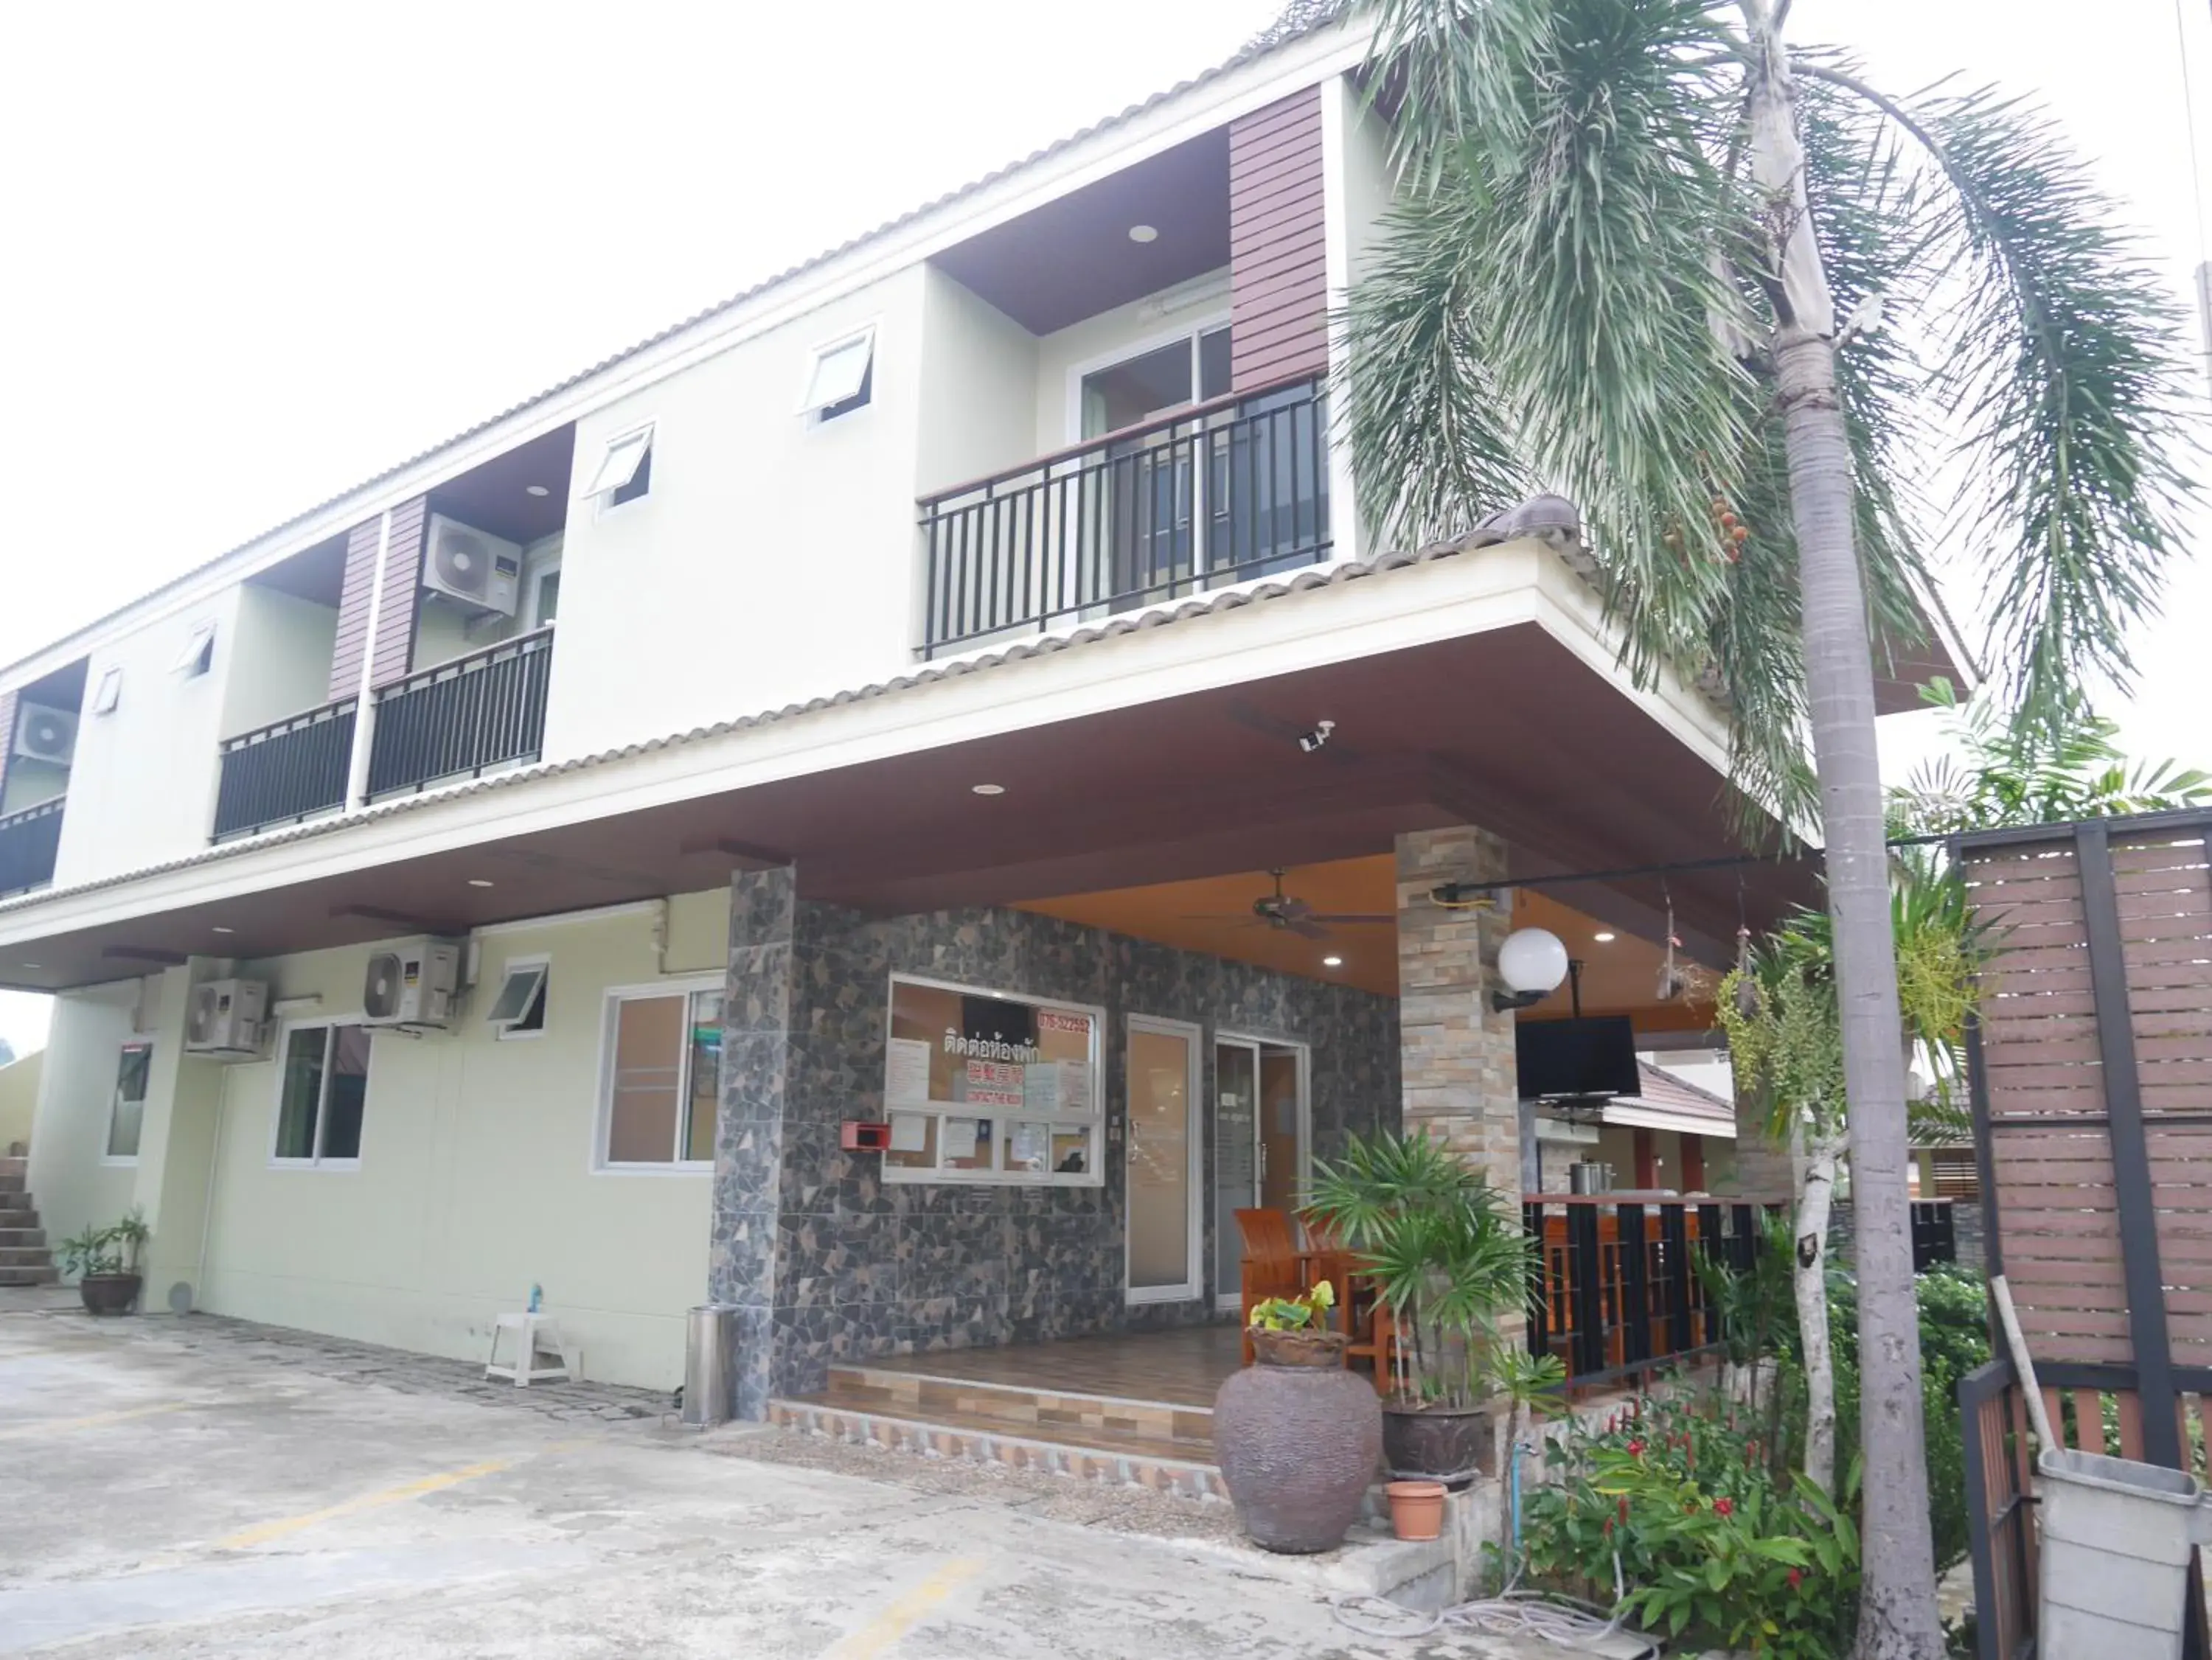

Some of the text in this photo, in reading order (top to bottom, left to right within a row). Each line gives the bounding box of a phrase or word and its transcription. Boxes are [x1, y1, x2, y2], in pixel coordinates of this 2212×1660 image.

[944, 1027, 1040, 1064] ติดต่อห้องพัก
